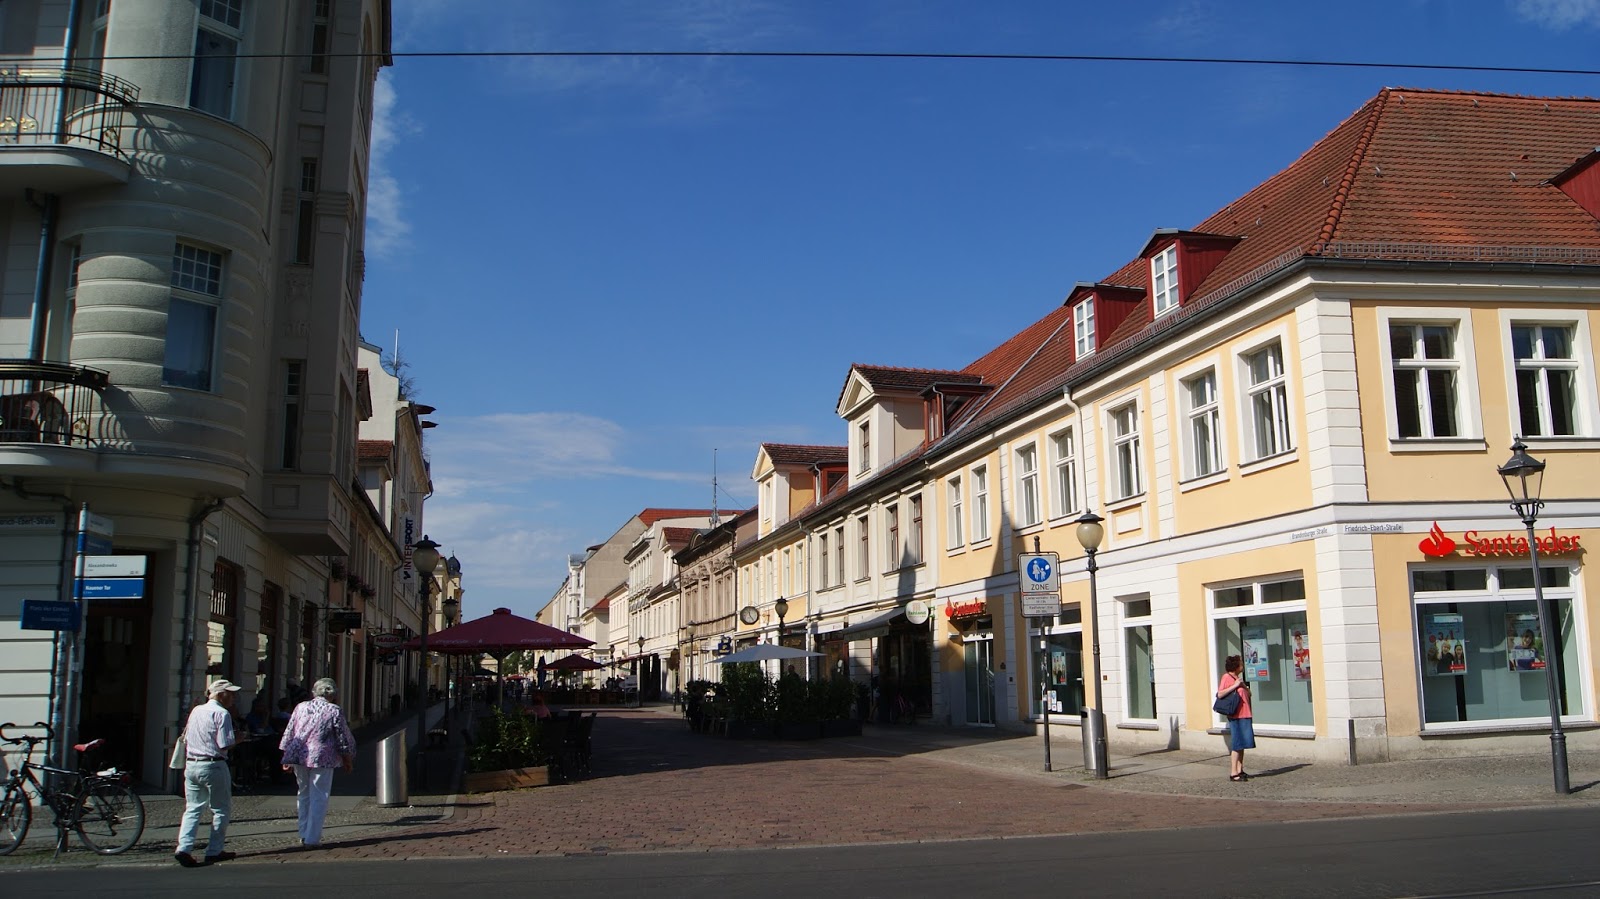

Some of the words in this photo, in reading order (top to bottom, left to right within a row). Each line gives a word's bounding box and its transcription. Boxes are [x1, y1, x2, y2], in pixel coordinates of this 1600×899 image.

[1291, 530, 1316, 540] Brandenburger
[1316, 526, 1329, 536] Straße
[1344, 524, 1402, 533] Friedrich-Ebert-Straße
[404, 518, 413, 570] INTERSPORT
[1463, 526, 1581, 555] Santander
[1031, 583, 1050, 591] ZONE
